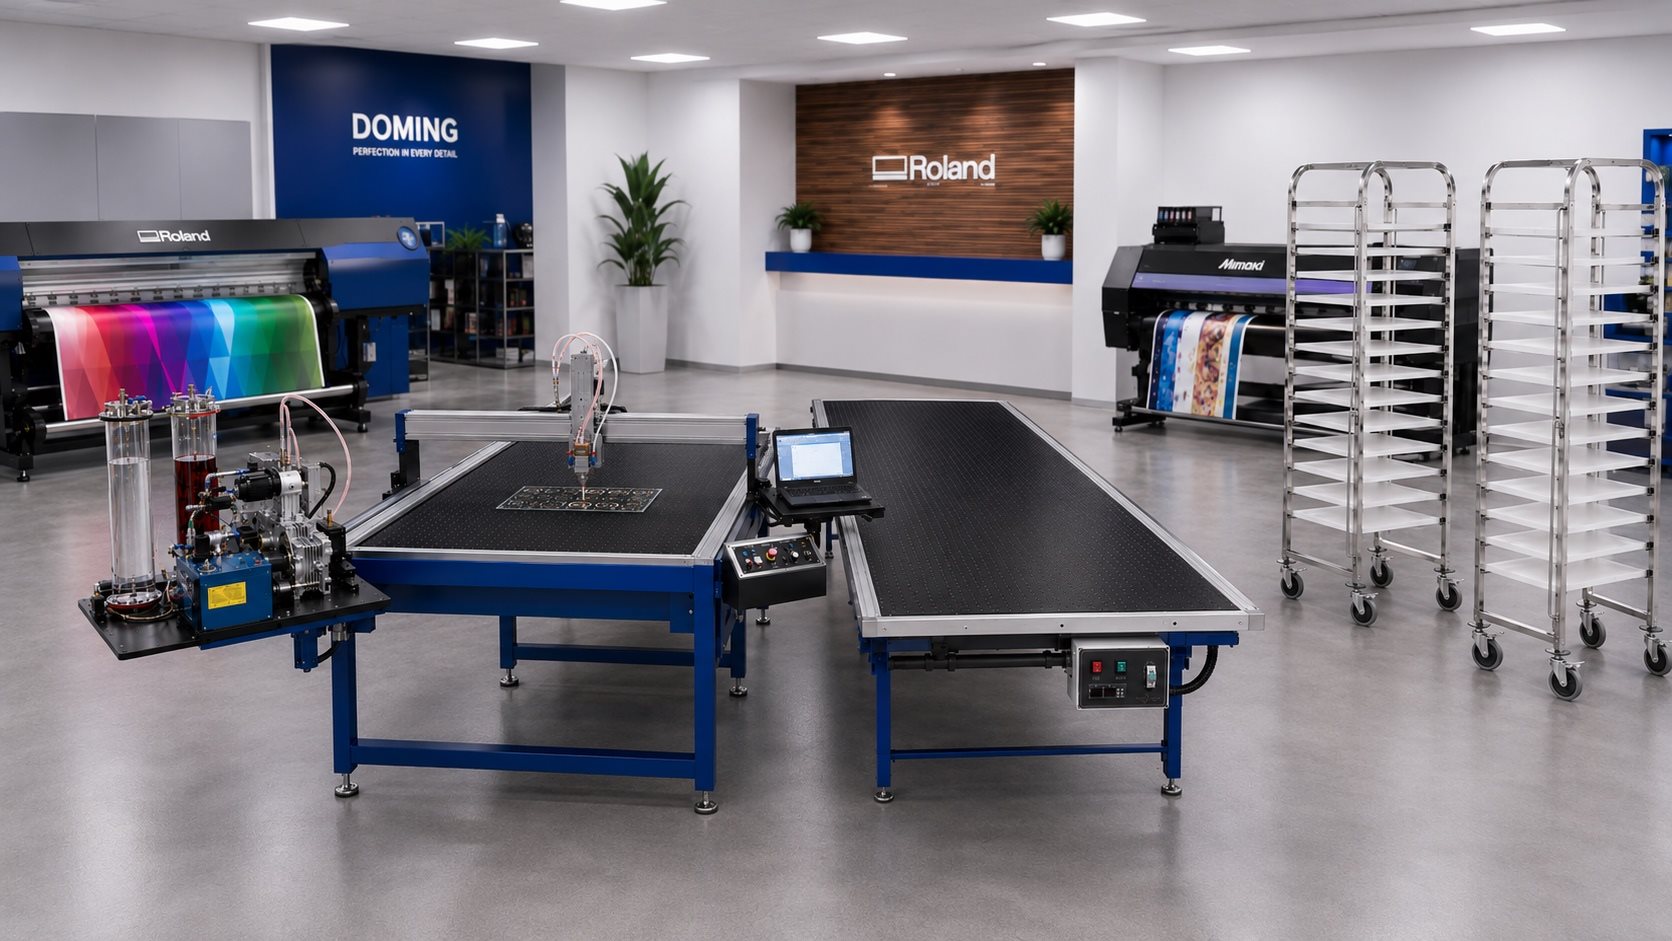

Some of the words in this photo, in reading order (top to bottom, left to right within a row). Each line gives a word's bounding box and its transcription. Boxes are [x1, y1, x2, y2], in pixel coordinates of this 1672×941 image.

[352, 113, 458, 143] DOMING
[353, 147, 400, 157] PERFECTION
[401, 148, 410, 157] IN
[410, 148, 433, 158] EVERY
[434, 149, 458, 159] DETAIL
[909, 153, 996, 181] Roland
[159, 229, 211, 242] Roland
[1218, 258, 1265, 271] Mimaki
